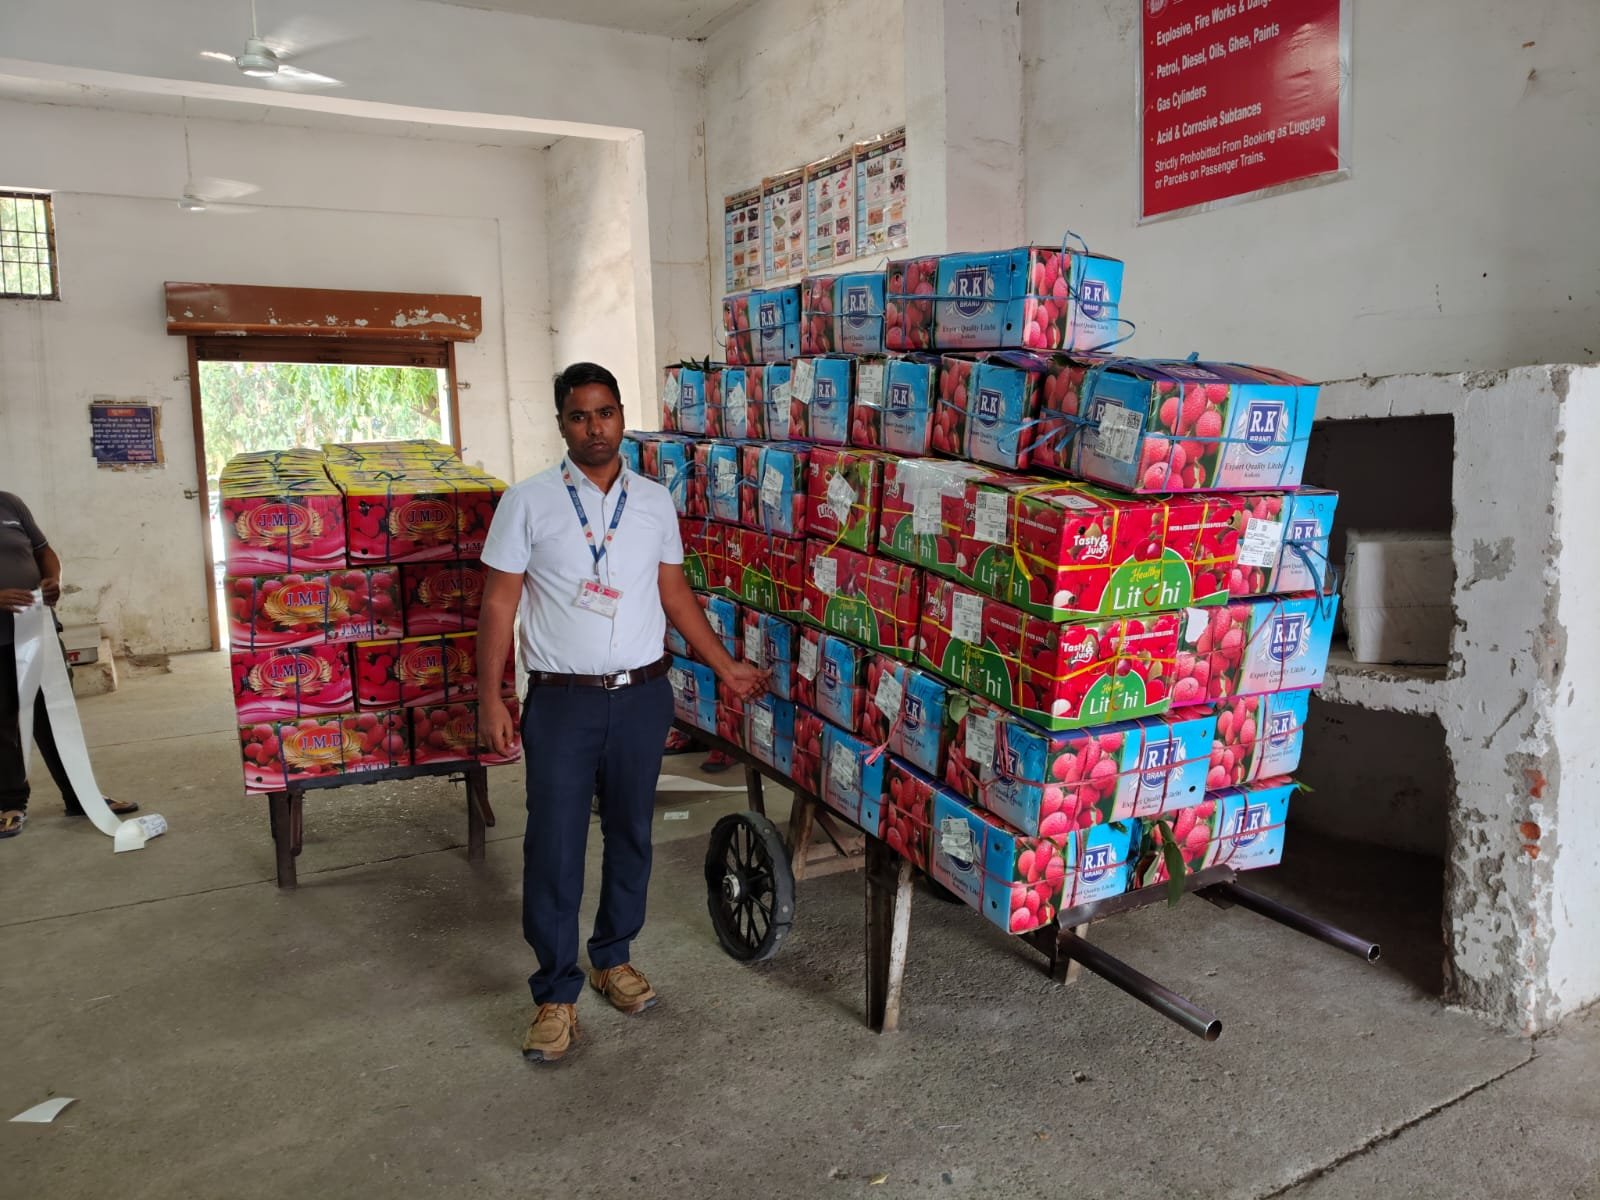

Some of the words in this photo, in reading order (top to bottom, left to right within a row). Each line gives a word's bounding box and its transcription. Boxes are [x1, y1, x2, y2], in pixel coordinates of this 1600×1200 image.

[1157, 21, 1193, 46] Explosive,
[1195, 15, 1210, 31] Fire
[1211, 3, 1236, 24] Works
[1238, 0, 1245, 13] &
[1247, 0, 1272, 10] Dang
[1157, 58, 1180, 79] Petrol,
[1182, 48, 1207, 70] Diesel,
[1209, 42, 1226, 60] Oils,
[1228, 35, 1251, 53] Ghee,
[1253, 22, 1280, 43] Paints
[1156, 97, 1170, 112] Gas
[1172, 85, 1207, 109] Cylinders
[1156, 127, 1172, 144] Acid
[1174, 125, 1181, 139] &
[1182, 115, 1218, 138] Corrosive
[1155, 154, 1178, 173] Strictly
[1222, 139, 1242, 154] From
[1243, 128, 1275, 148] Booking
[1277, 126, 1287, 138] as
[1289, 115, 1326, 136] Luggage
[1155, 178, 1163, 190] or
[1163, 170, 1189, 187] Parcels
[1190, 170, 1199, 181] on
[1200, 158, 1239, 178] Passenger
[1240, 151, 1266, 167] Trains.
[962, 277, 982, 297] R.K
[850, 293, 866, 312] R.K
[893, 388, 908, 405] R.K
[981, 395, 999, 414] R.K
[1250, 410, 1278, 433] R.K
[1245, 462, 1266, 471] Quality
[1267, 462, 1286, 470] Litch
[1294, 526, 1316, 541] RK
[1129, 566, 1161, 582] Healthy
[1146, 770, 1168, 781] BRAN
[1084, 851, 1107, 871] R.K
